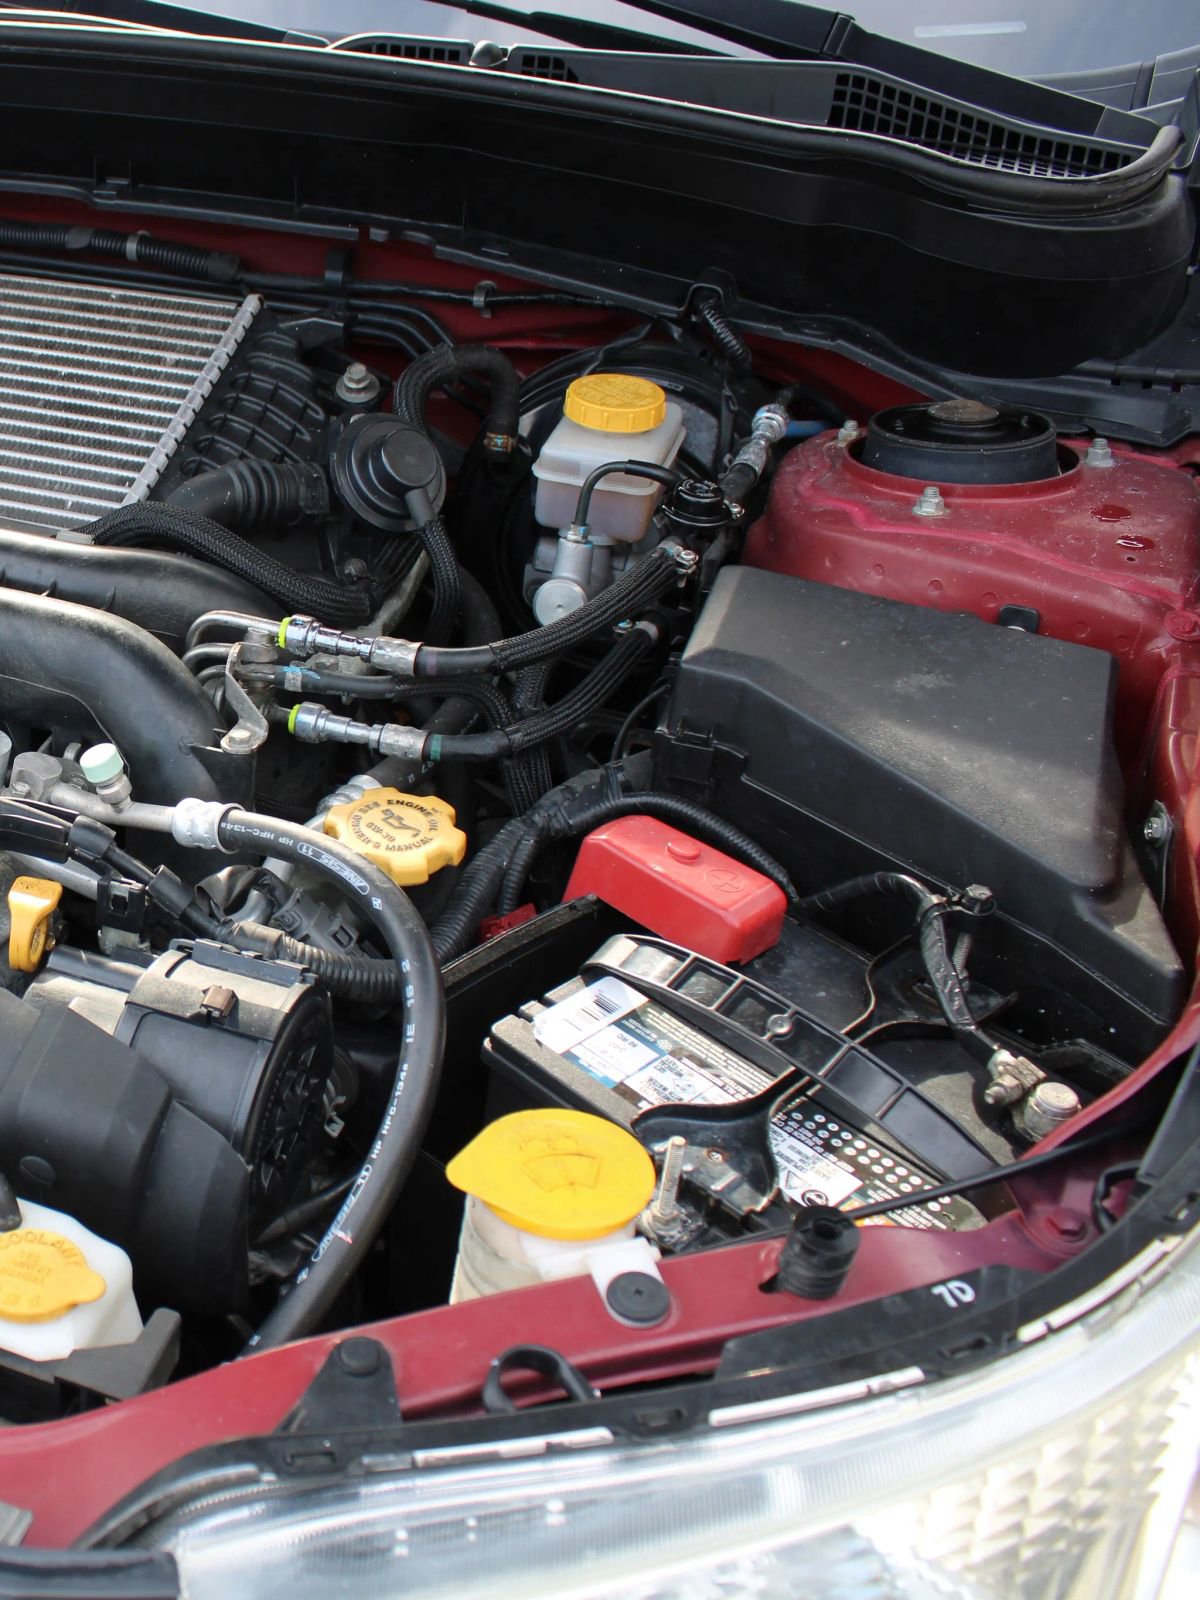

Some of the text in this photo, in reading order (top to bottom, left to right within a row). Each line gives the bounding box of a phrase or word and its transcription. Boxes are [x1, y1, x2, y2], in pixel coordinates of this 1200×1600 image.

[387, 799, 433, 817] ENGINE
[278, 836, 293, 846] HP
[385, 836, 433, 852] MANUAL
[931, 1280, 975, 1308] 7D
